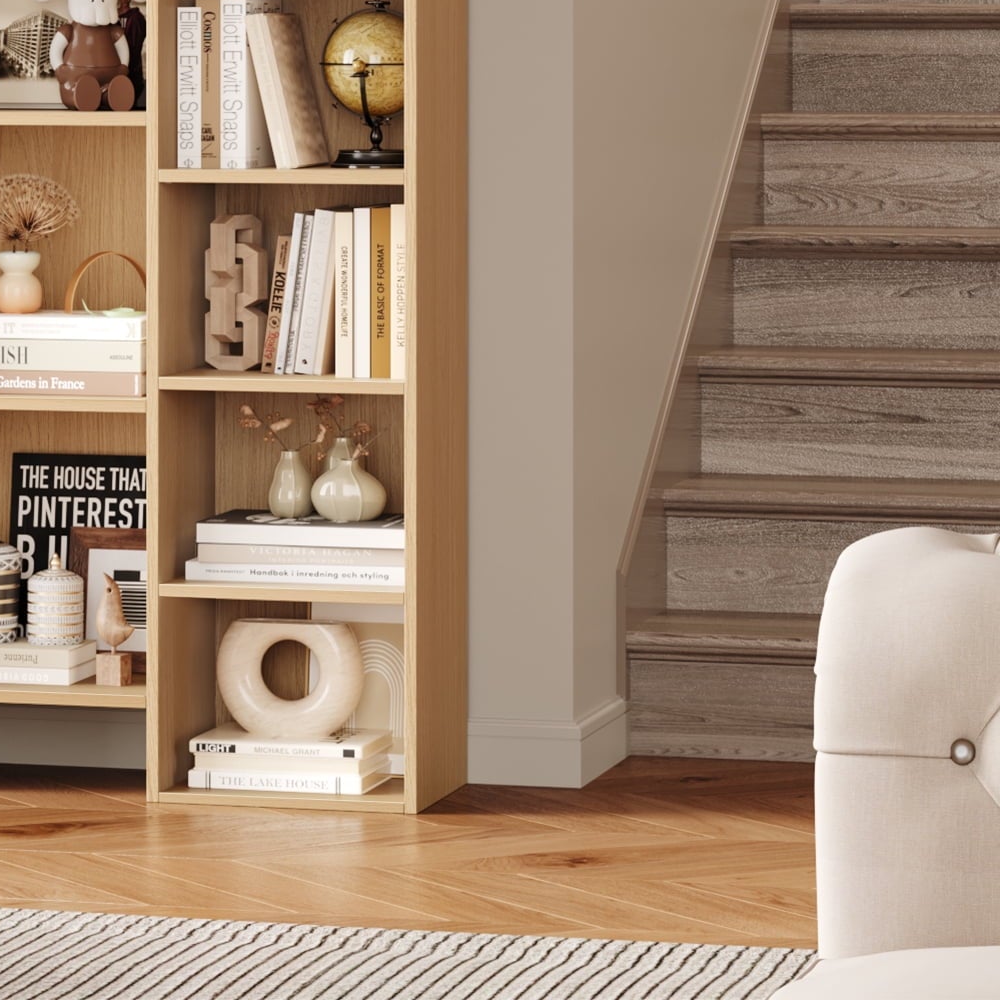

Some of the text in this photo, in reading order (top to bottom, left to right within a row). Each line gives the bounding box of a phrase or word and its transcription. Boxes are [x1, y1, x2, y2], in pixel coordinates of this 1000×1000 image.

[203, 11, 216, 53] Cosmos
[178, 11, 198, 150] Elliott Erwitt Snaps
[220, 3, 243, 151] Elliott Erwitt Snaps
[376, 243, 385, 339] THE BASIC OF FORMAT
[396, 243, 405, 347] KELLY HOPPEN STYLE
[3, 322, 15, 334] IT
[38, 377, 49, 389] in
[51, 377, 86, 390] France
[19, 465, 146, 492] THE HOUSE THAT
[17, 495, 146, 529] PINTEREST
[249, 568, 288, 577] Handbok
[296, 569, 339, 580] inredning
[341, 570, 357, 578] och
[360, 571, 389, 581] styling
[3, 653, 38, 664] Purienne
[199, 743, 231, 753] LIGHT
[253, 746, 321, 756] MICHAEL GRANT
[218, 775, 329, 790] THE LAKE HOUSE
